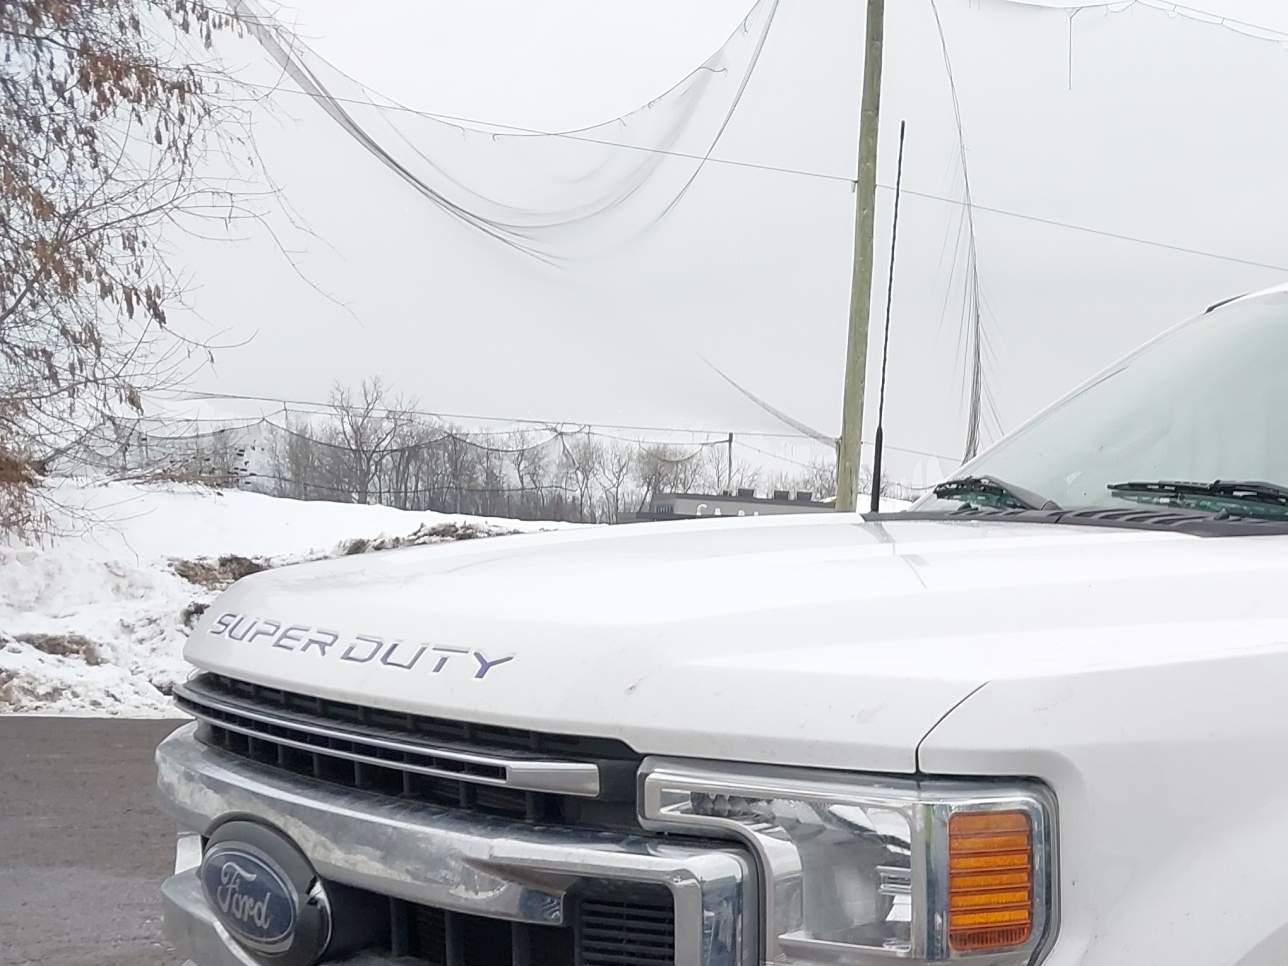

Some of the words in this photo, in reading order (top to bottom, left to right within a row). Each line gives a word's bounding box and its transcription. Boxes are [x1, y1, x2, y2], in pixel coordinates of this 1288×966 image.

[209, 612, 339, 657] SUPER
[340, 634, 516, 681] DUTY
[216, 860, 273, 930] Ford
